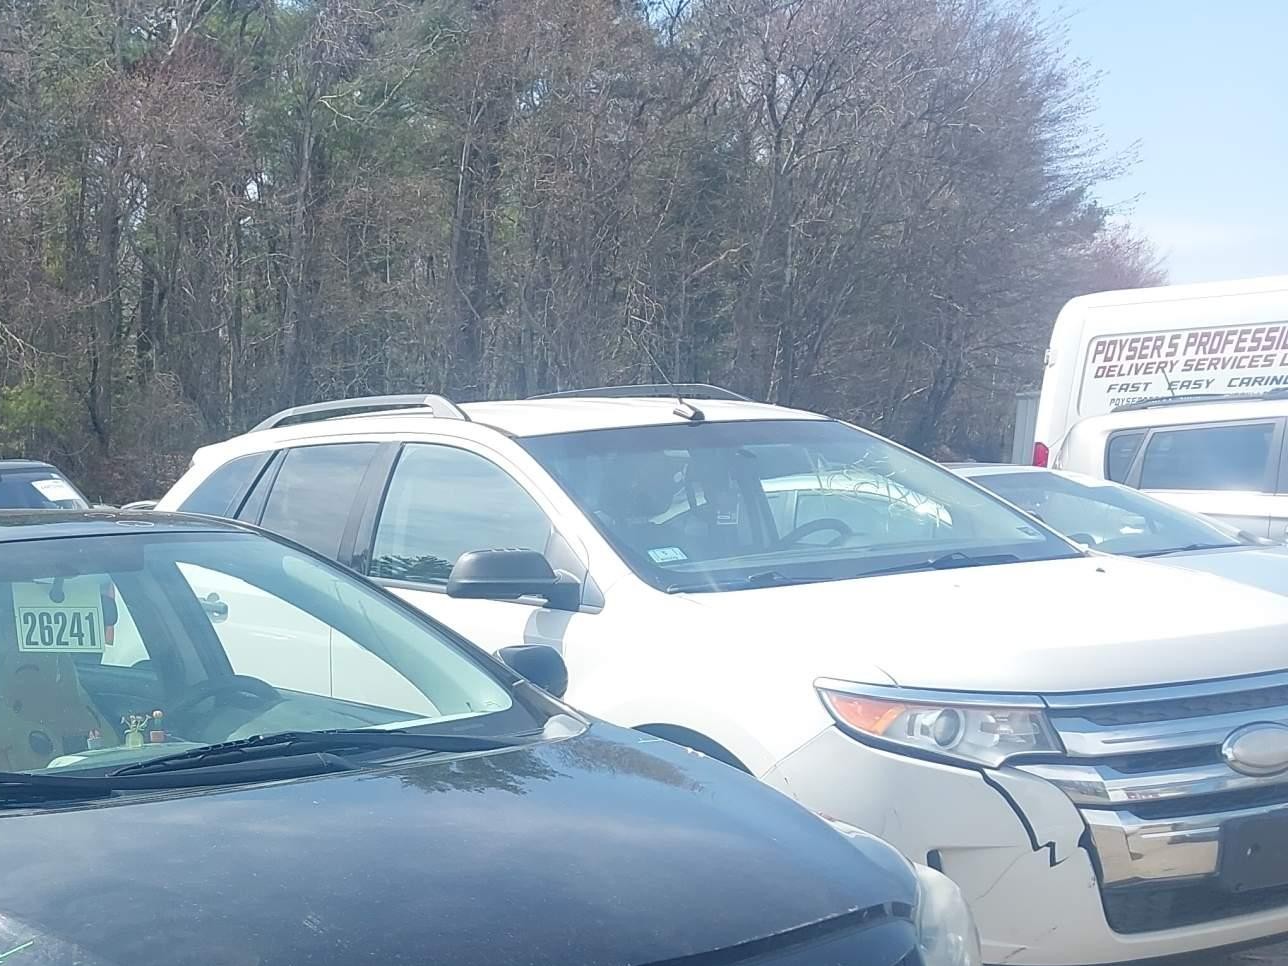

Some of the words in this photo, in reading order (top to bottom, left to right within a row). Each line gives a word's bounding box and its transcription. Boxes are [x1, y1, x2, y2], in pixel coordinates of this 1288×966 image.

[1094, 360, 1179, 379] DELIVERY
[1181, 354, 1277, 372] SERVICES
[1107, 382, 1153, 393] FAST
[1168, 378, 1216, 391] EASY
[23, 611, 97, 647] 26241
